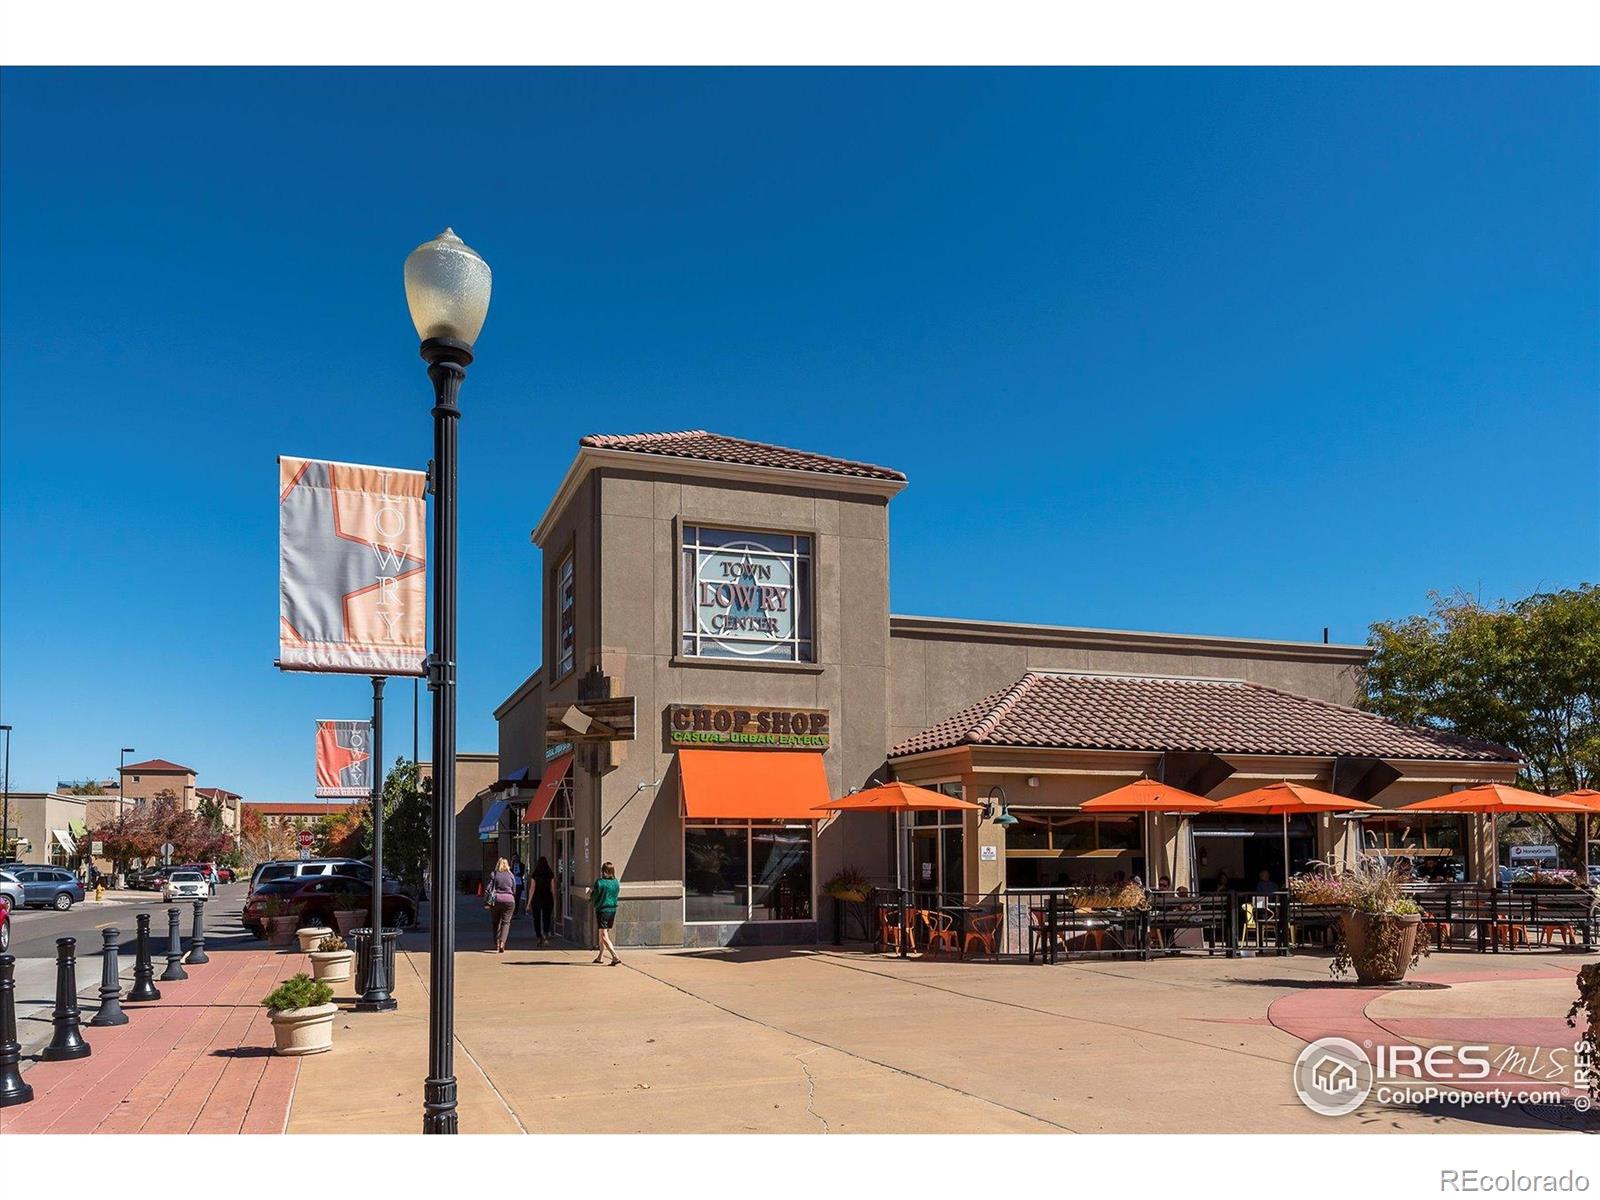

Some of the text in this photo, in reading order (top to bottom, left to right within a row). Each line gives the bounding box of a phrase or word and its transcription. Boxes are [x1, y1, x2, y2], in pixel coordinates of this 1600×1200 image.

[368, 471, 410, 641] LOWRY
[720, 562, 771, 580] TOWN
[700, 582, 788, 612] LOWRY
[711, 614, 779, 632] CENTER
[673, 707, 828, 735] CHOP SHOP
[672, 731, 829, 746] CASUAL URBAN EATERY
[350, 722, 364, 786] LOWRY
